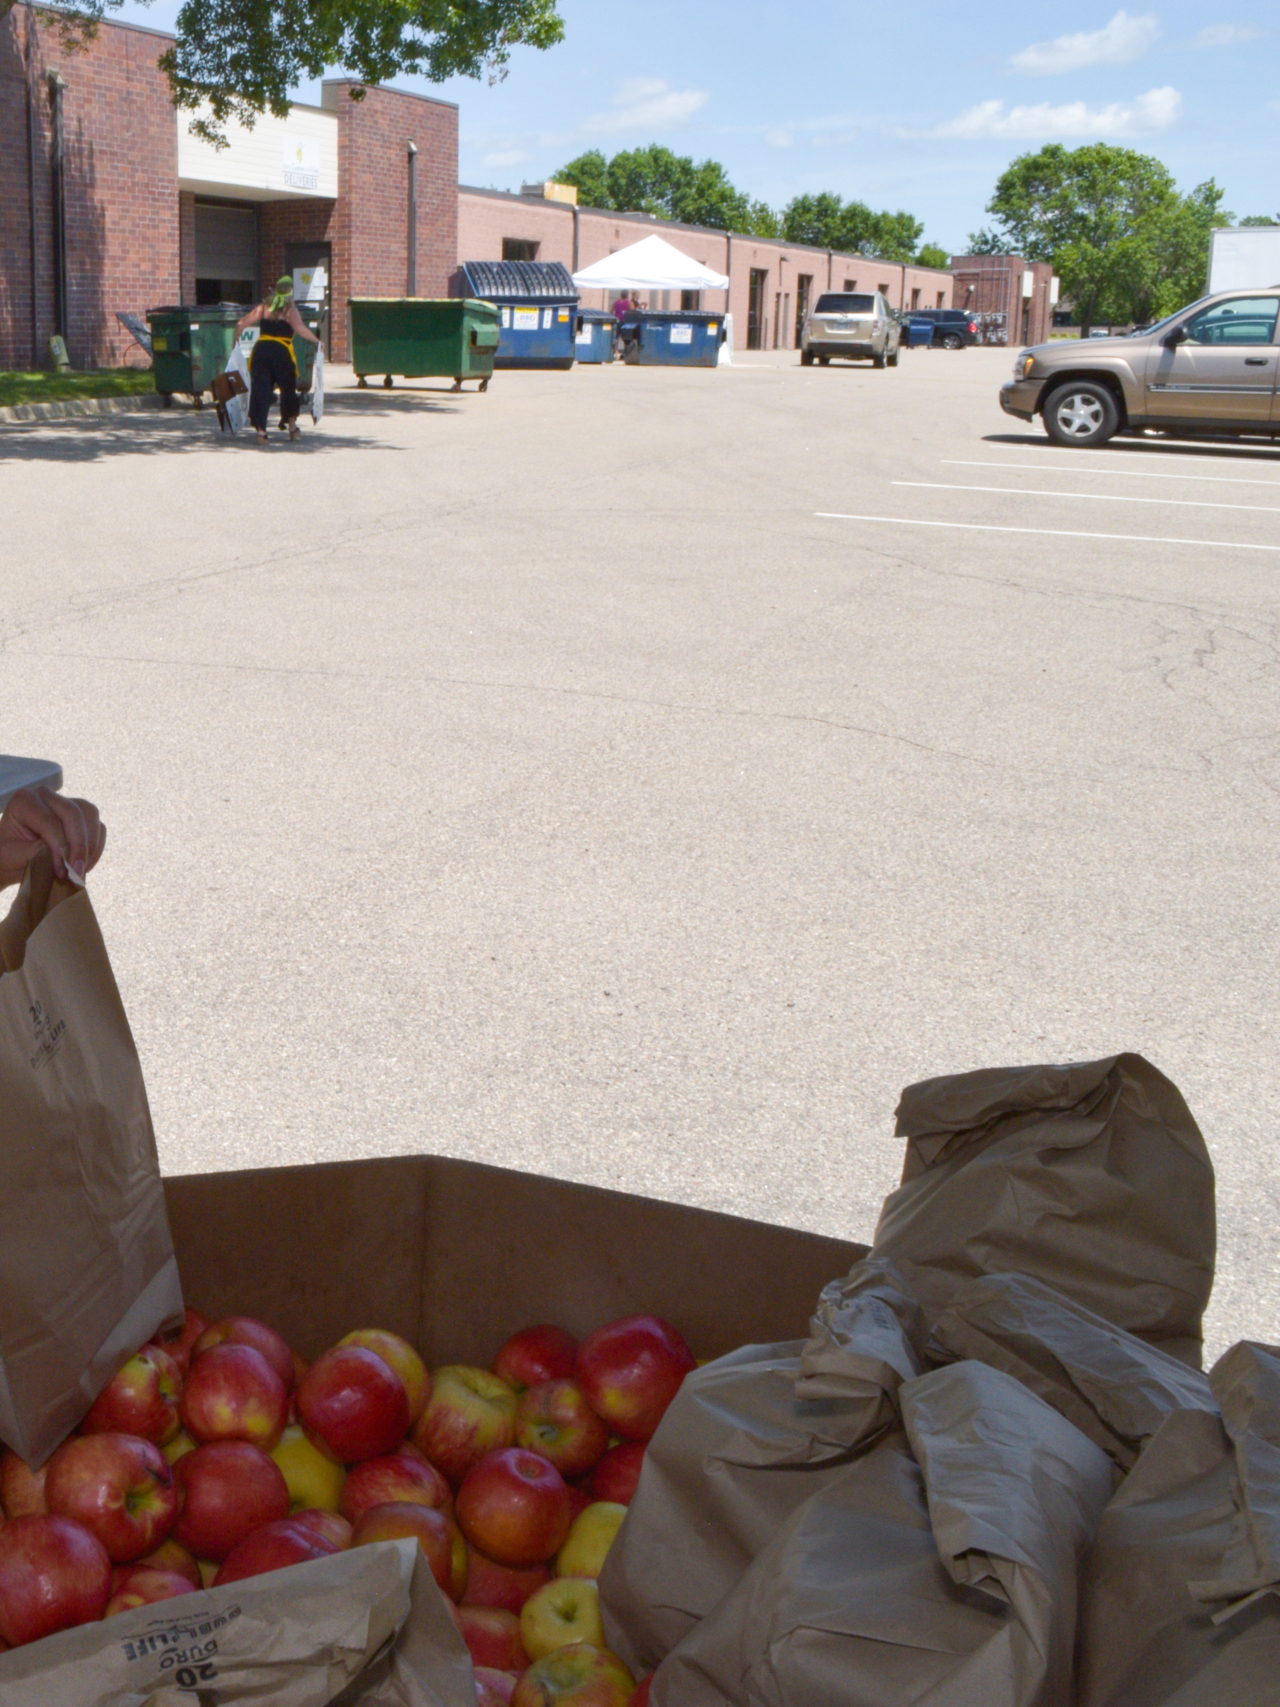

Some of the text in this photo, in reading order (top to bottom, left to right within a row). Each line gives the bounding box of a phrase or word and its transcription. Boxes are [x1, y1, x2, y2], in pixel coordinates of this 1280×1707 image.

[284, 173, 318, 188] DELIVERIES
[122, 1633, 169, 1662] LIFE
[159, 1639, 218, 1670] DURO
[176, 1662, 219, 1688] 20
